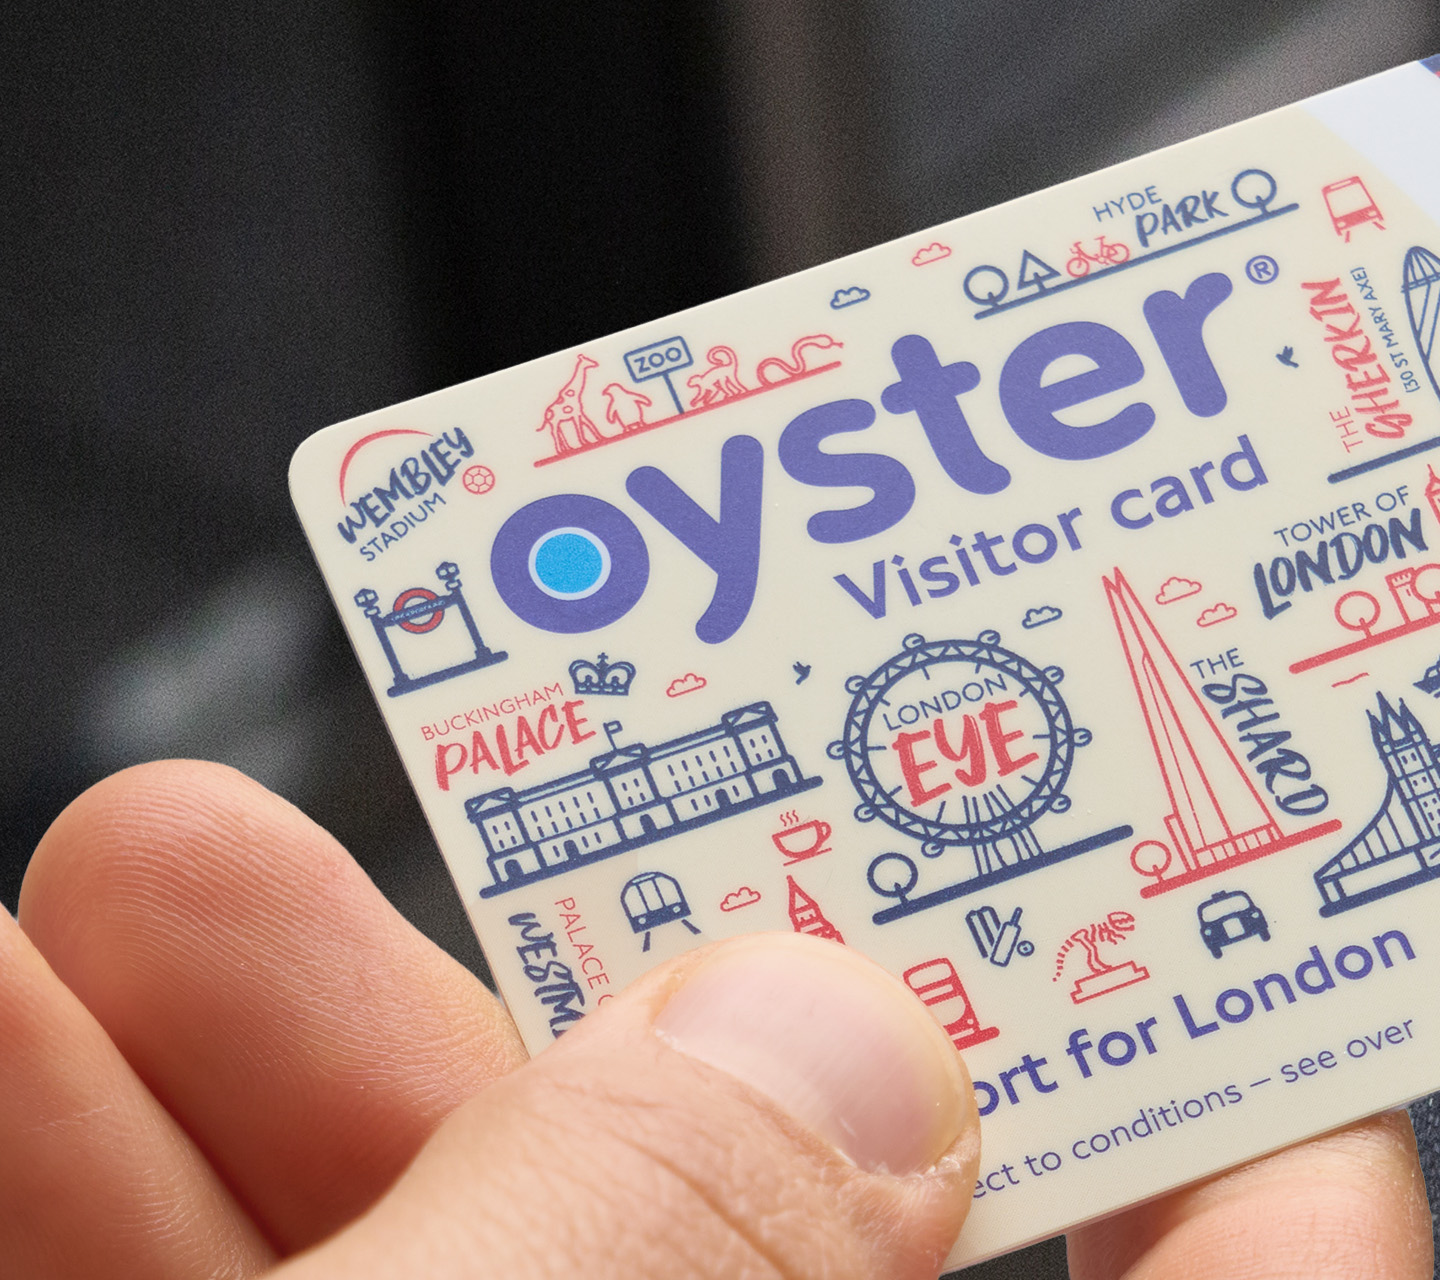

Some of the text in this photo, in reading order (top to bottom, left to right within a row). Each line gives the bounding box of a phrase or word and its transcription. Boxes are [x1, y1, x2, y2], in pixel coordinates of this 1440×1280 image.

[1092, 185, 1162, 222] HYDE
[1135, 190, 1229, 247] PARK
[633, 347, 682, 373] ZOO
[1301, 277, 1413, 439] GHERKIN
[1350, 267, 1420, 393] (30 ST MARY AXE)
[491, 272, 1233, 644] oyster
[1329, 406, 1363, 453] THE
[337, 427, 475, 544] WEMBLEY
[360, 492, 446, 562] STADIUM
[834, 434, 1269, 620] Visitor card
[1273, 485, 1412, 544] TOWER OF
[1252, 507, 1429, 620] LONDON
[882, 674, 1007, 731] LONDON
[1190, 648, 1245, 678] THE
[420, 682, 564, 741] BUCKINGHAM
[435, 700, 596, 791] PALACE
[891, 700, 1040, 807] EYE
[1201, 673, 1329, 817] SHARD
[554, 897, 610, 990] PALACE
[1066, 1016, 1158, 1079] for
[1173, 929, 1417, 1040] London
[1024, 1151, 1062, 1178] to
[1072, 1083, 1243, 1160] conditions
[1281, 1050, 1338, 1083] see
[1346, 1018, 1414, 1059] over
